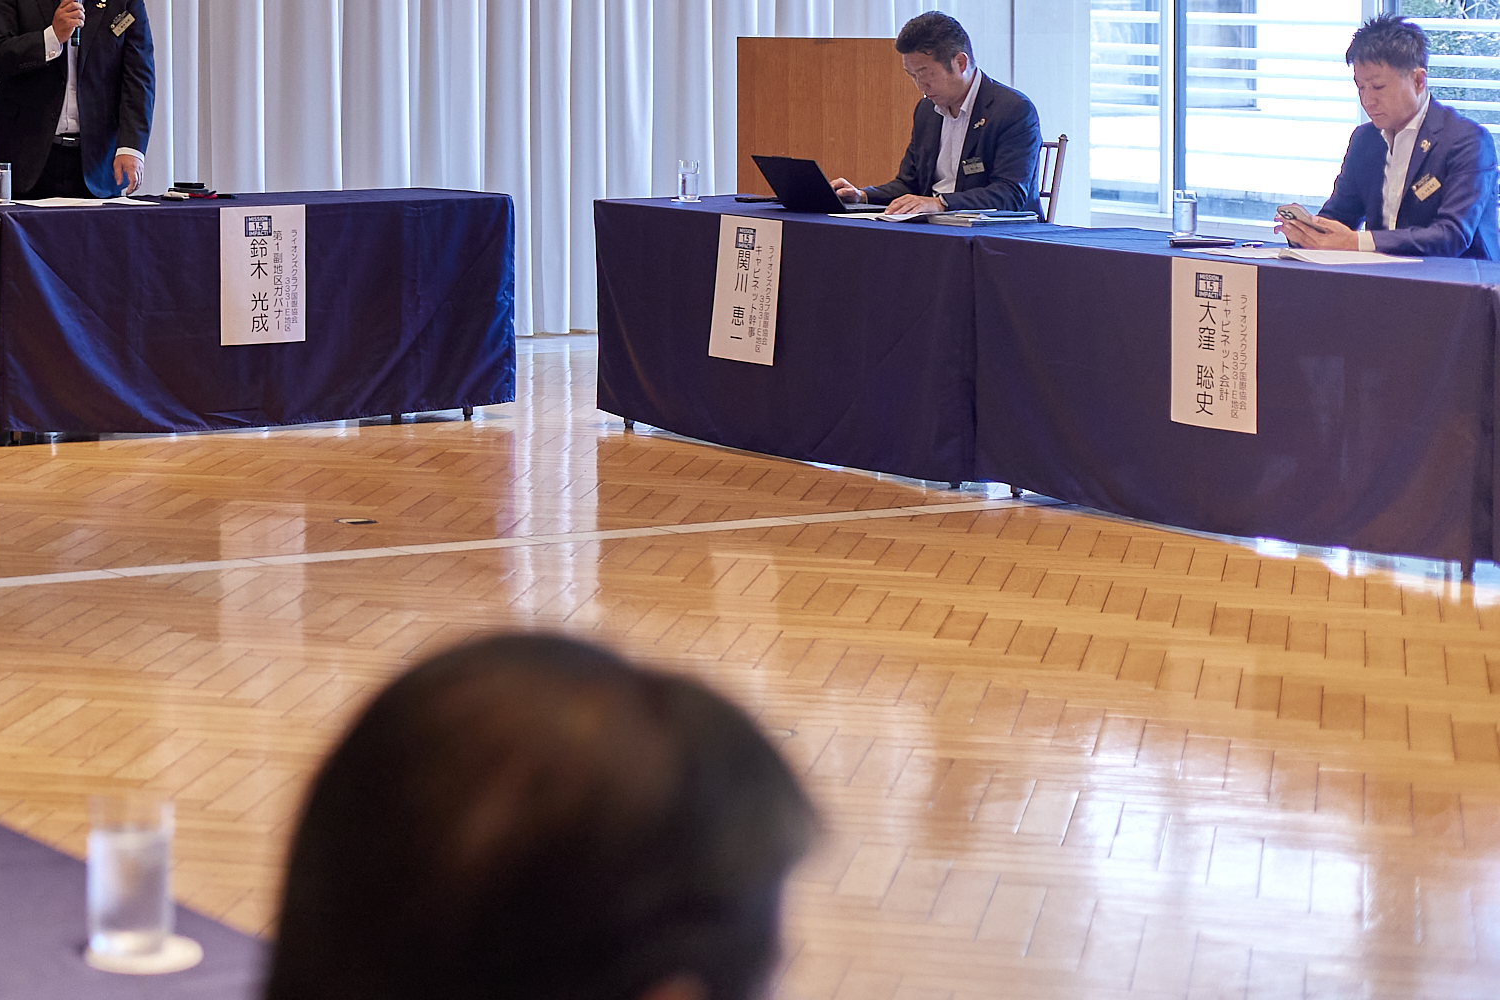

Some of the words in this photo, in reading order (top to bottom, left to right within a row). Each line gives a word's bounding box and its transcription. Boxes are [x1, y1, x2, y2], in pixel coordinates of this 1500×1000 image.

[250, 238, 268, 279] 鈴木
[734, 249, 751, 293] 関川
[251, 292, 269, 333] 光成
[1198, 301, 1217, 351] 大窪
[1195, 365, 1215, 416] 聡史
